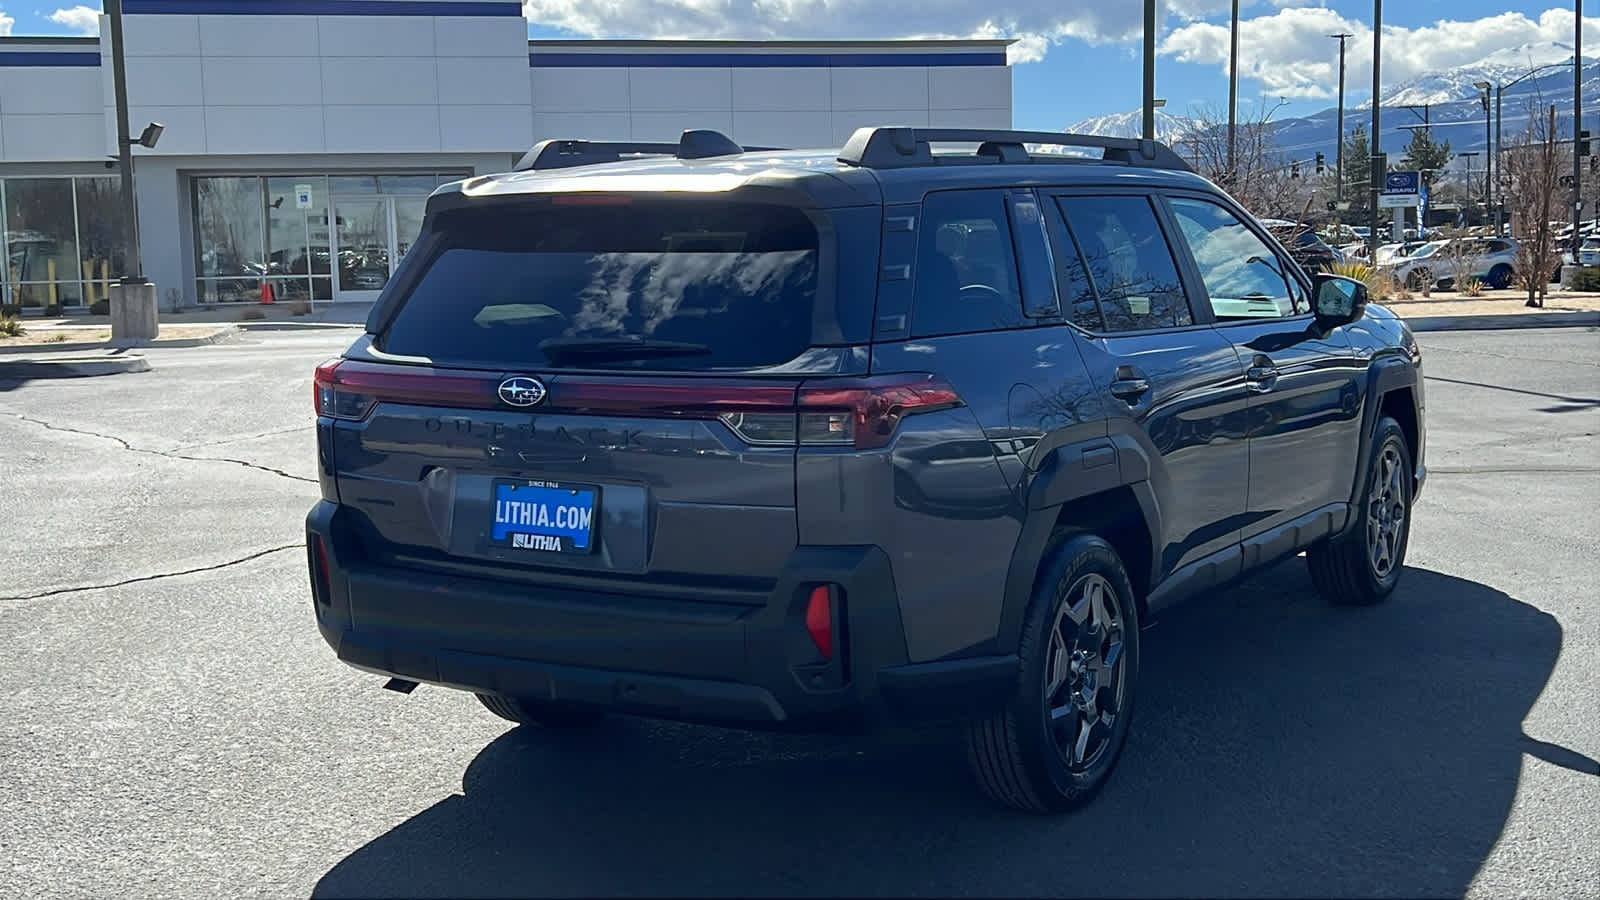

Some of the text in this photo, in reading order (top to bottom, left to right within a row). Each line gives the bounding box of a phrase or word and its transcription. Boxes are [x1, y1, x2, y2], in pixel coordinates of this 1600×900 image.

[425, 416, 643, 446] OUTBACK
[495, 500, 592, 531] LITHIA.COM
[523, 534, 562, 552] LITHIA
